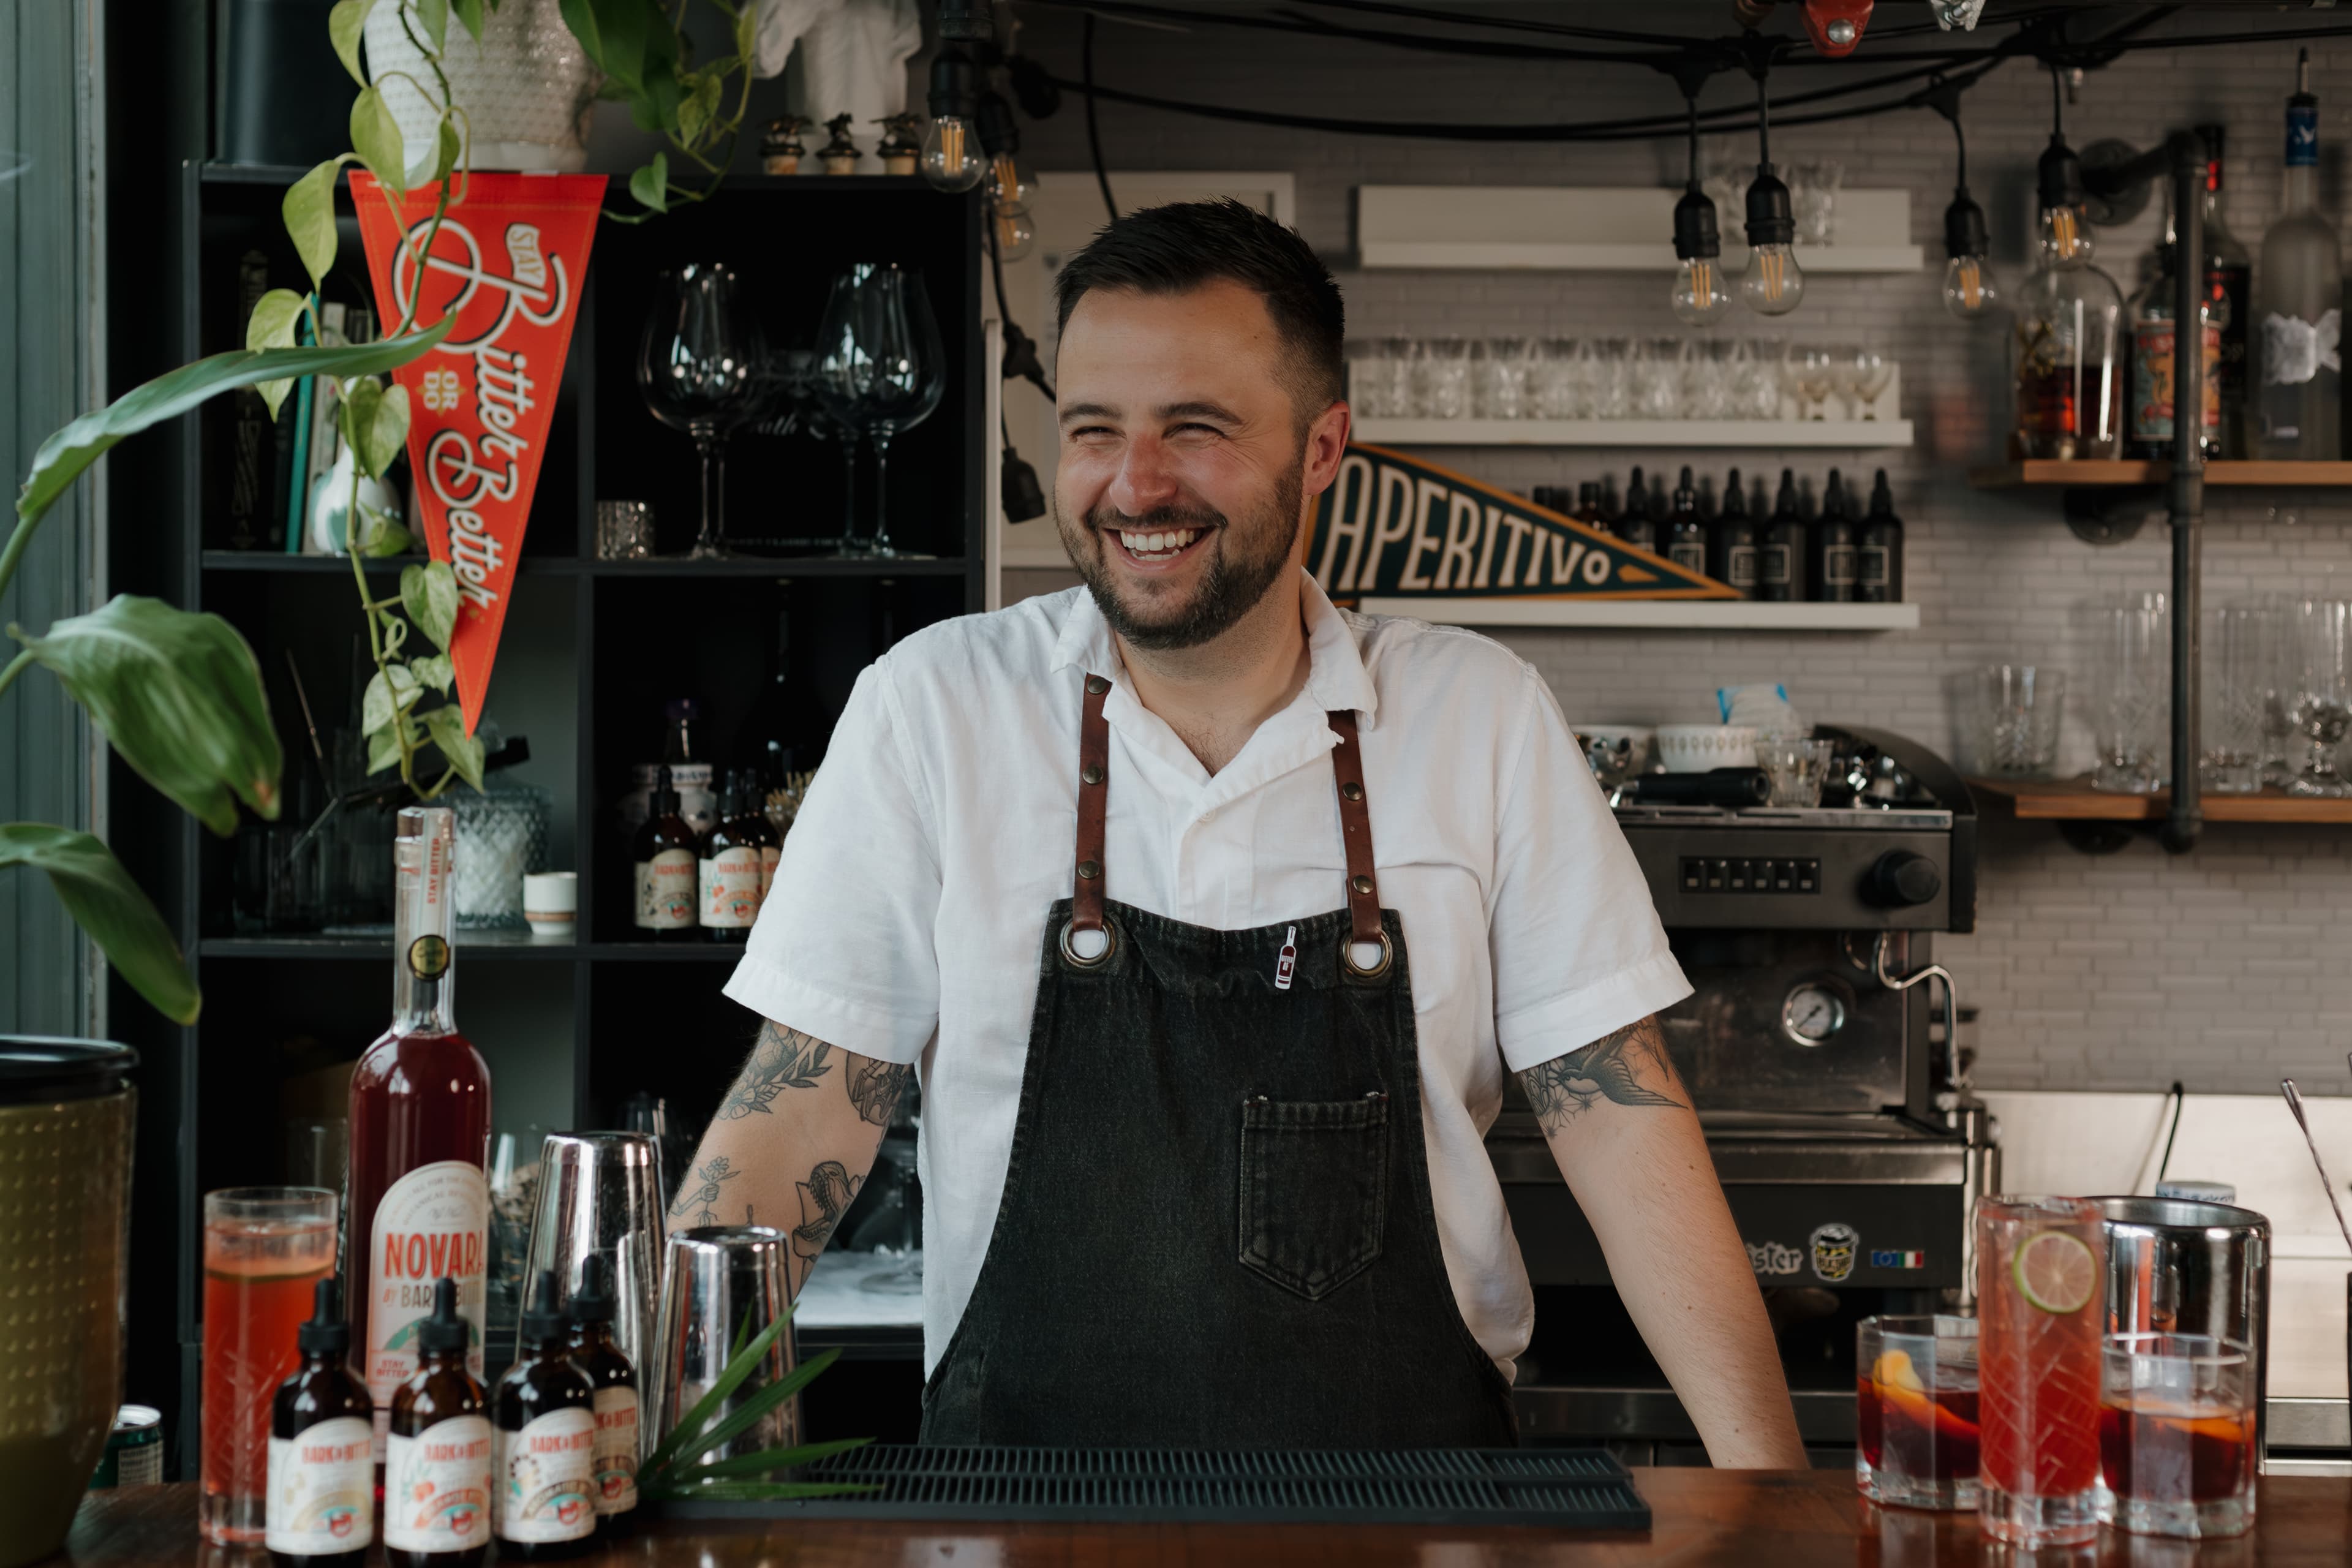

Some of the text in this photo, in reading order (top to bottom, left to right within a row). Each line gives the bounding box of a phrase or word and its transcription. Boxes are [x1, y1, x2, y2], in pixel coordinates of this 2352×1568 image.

[509, 230, 541, 279] STAY
[393, 217, 568, 461] Bitter
[423, 371, 440, 410] DO
[442, 371, 459, 410] OR
[425, 429, 518, 608] Better
[427, 838, 441, 903] STAY BITTER
[1749, 1247, 1799, 1270] ster
[400, 1284, 432, 1308] BAR
[382, 1359, 404, 1368] STAY
[302, 1446, 334, 1463] BARK
[424, 1444, 455, 1461] BARK
